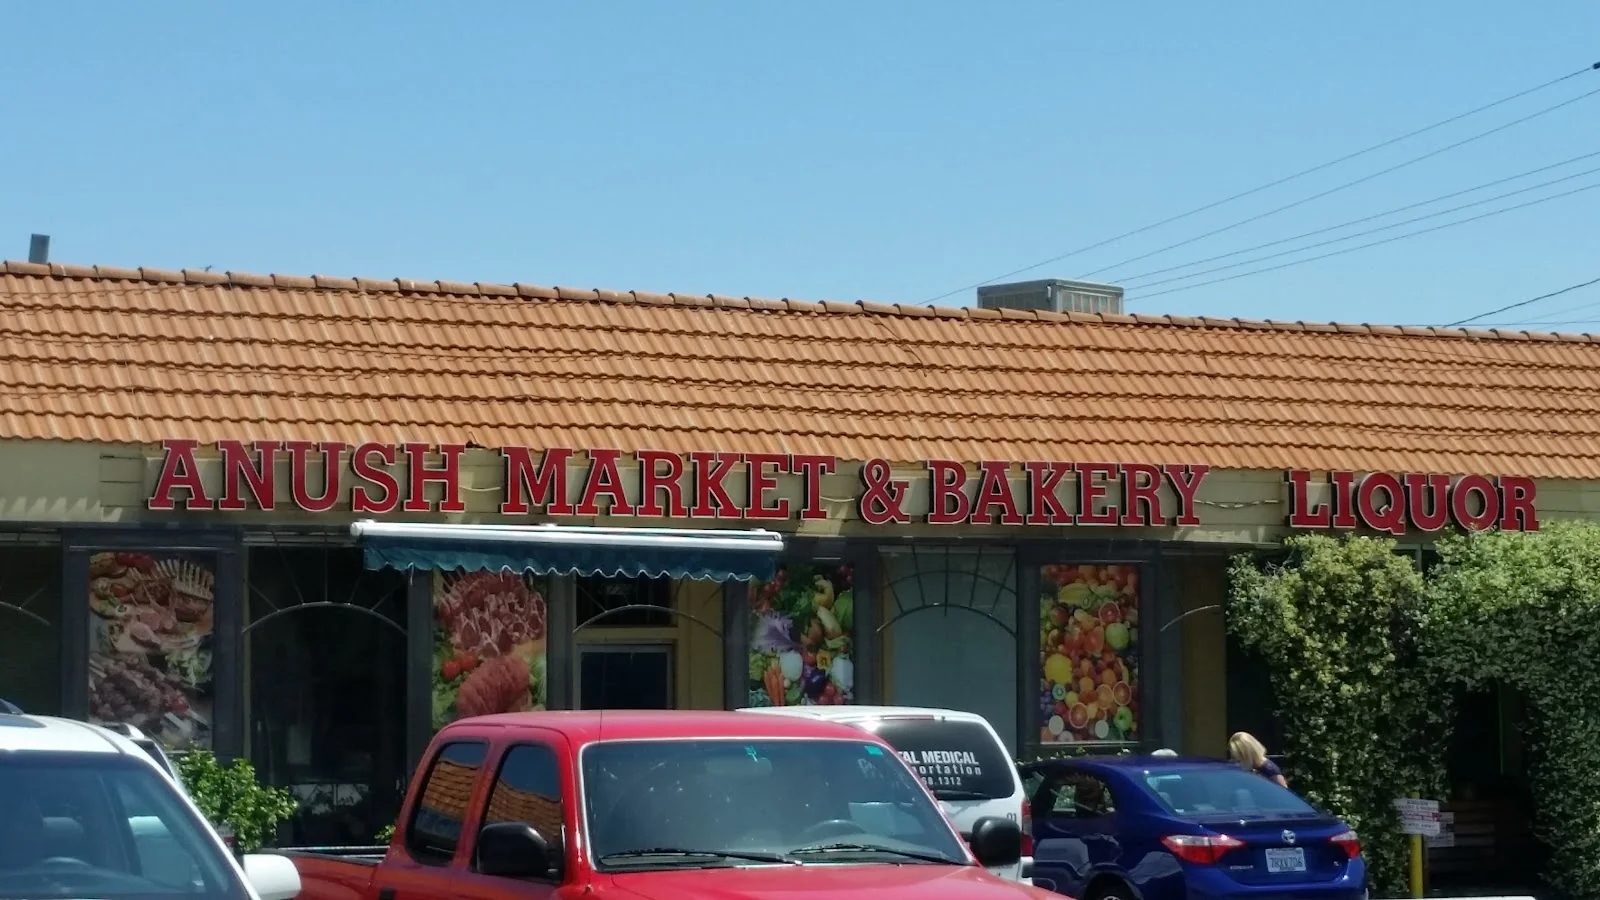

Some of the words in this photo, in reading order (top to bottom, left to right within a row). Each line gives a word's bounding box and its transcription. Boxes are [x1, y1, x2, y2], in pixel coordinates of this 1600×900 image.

[148, 438, 466, 513] ANUSH
[501, 446, 836, 520] MARKET
[860, 457, 911, 525] &
[927, 459, 1210, 526] BAKERY
[1288, 469, 1540, 535] LIQUOR
[922, 751, 979, 764] MEDICAL
